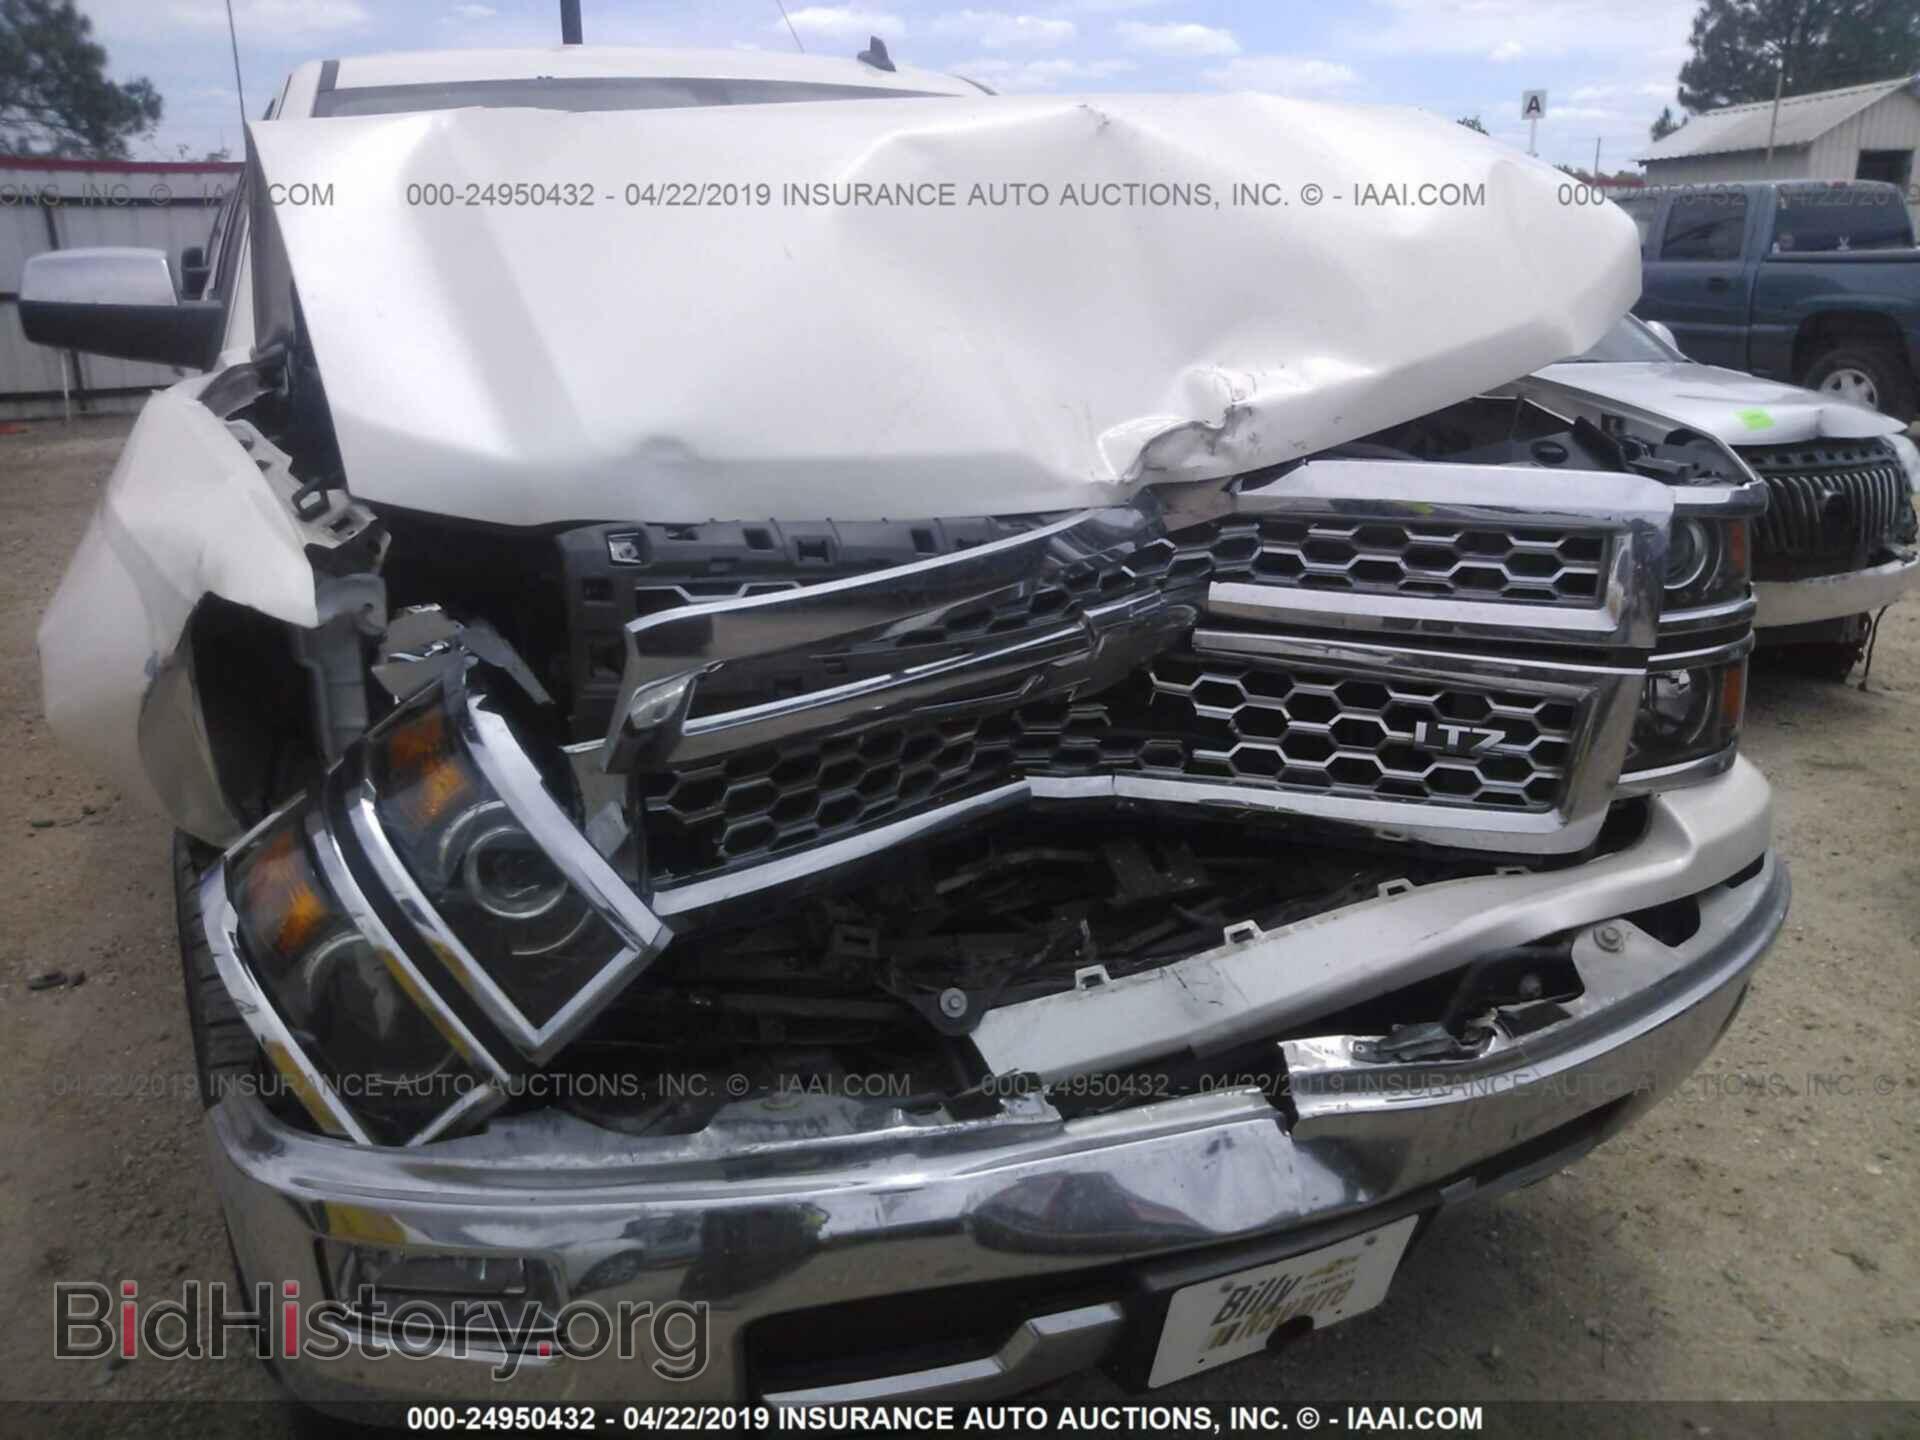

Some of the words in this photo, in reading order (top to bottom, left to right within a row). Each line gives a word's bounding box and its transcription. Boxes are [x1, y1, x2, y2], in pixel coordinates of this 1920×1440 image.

[1525, 95, 1541, 114] A
[1414, 721, 1506, 753] LTZ
[1210, 1273, 1303, 1327] Billy
